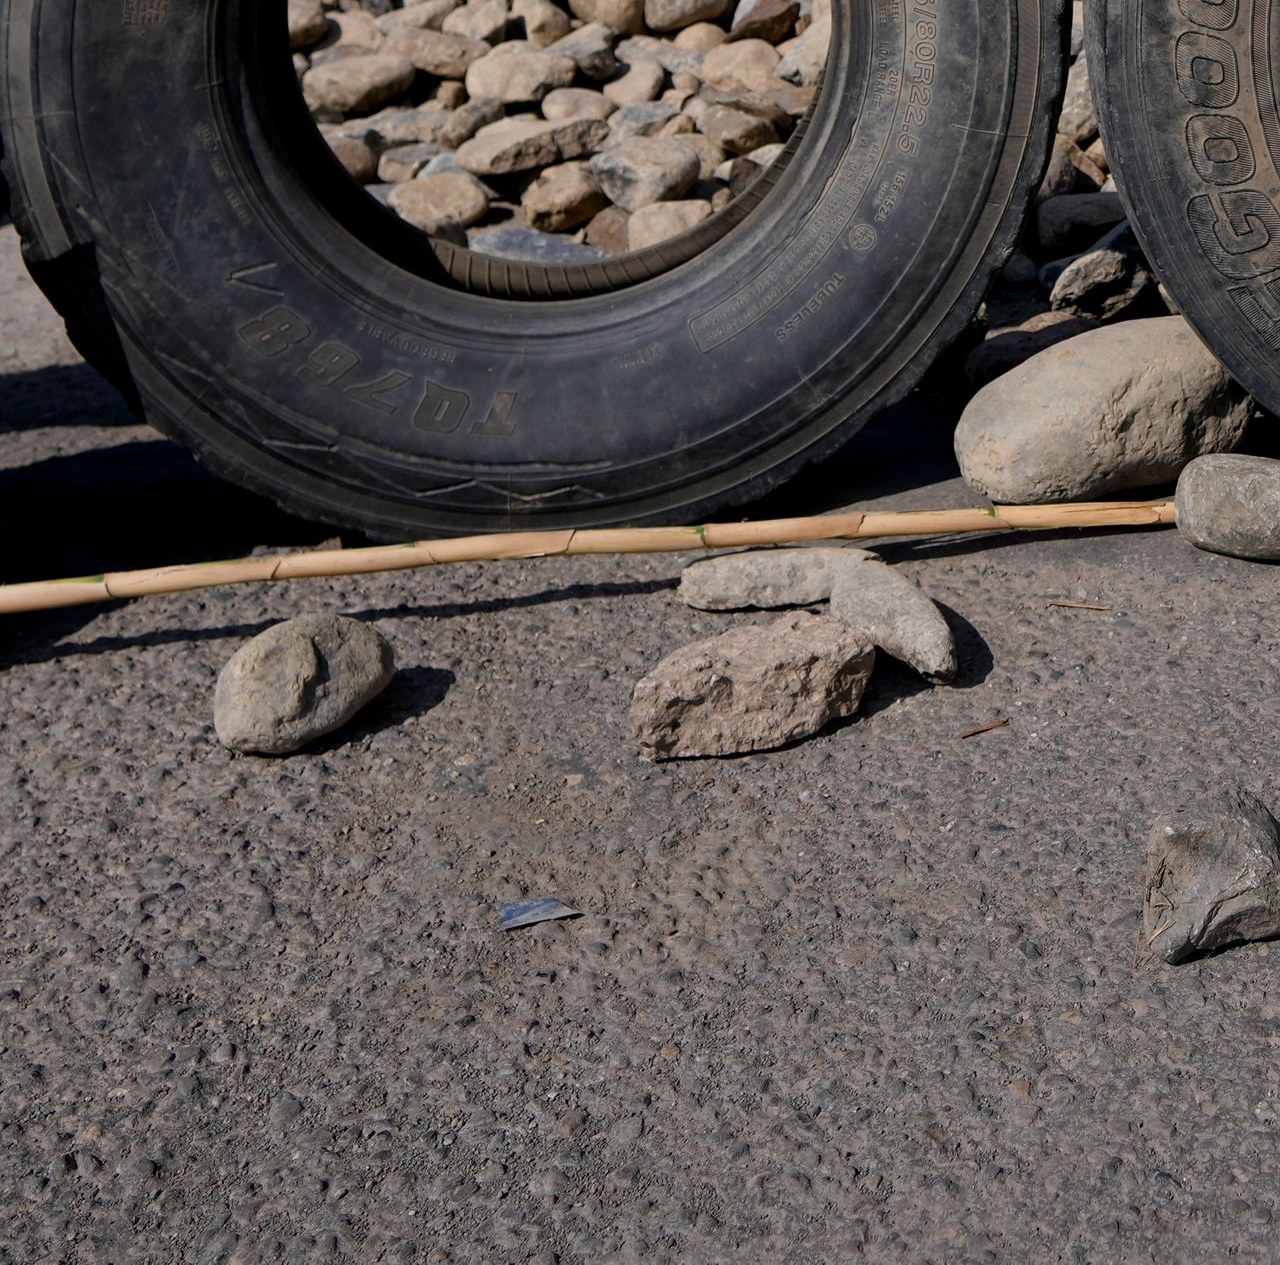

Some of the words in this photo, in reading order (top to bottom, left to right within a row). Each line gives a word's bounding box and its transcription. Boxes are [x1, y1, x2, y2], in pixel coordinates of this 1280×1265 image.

[876, 41, 889, 68] LOAD
[868, 73, 884, 107] RANGE
[873, 171, 907, 223] 156/152L
[774, 273, 846, 342] TUBELESS
[238, 306, 518, 436] TQ768
